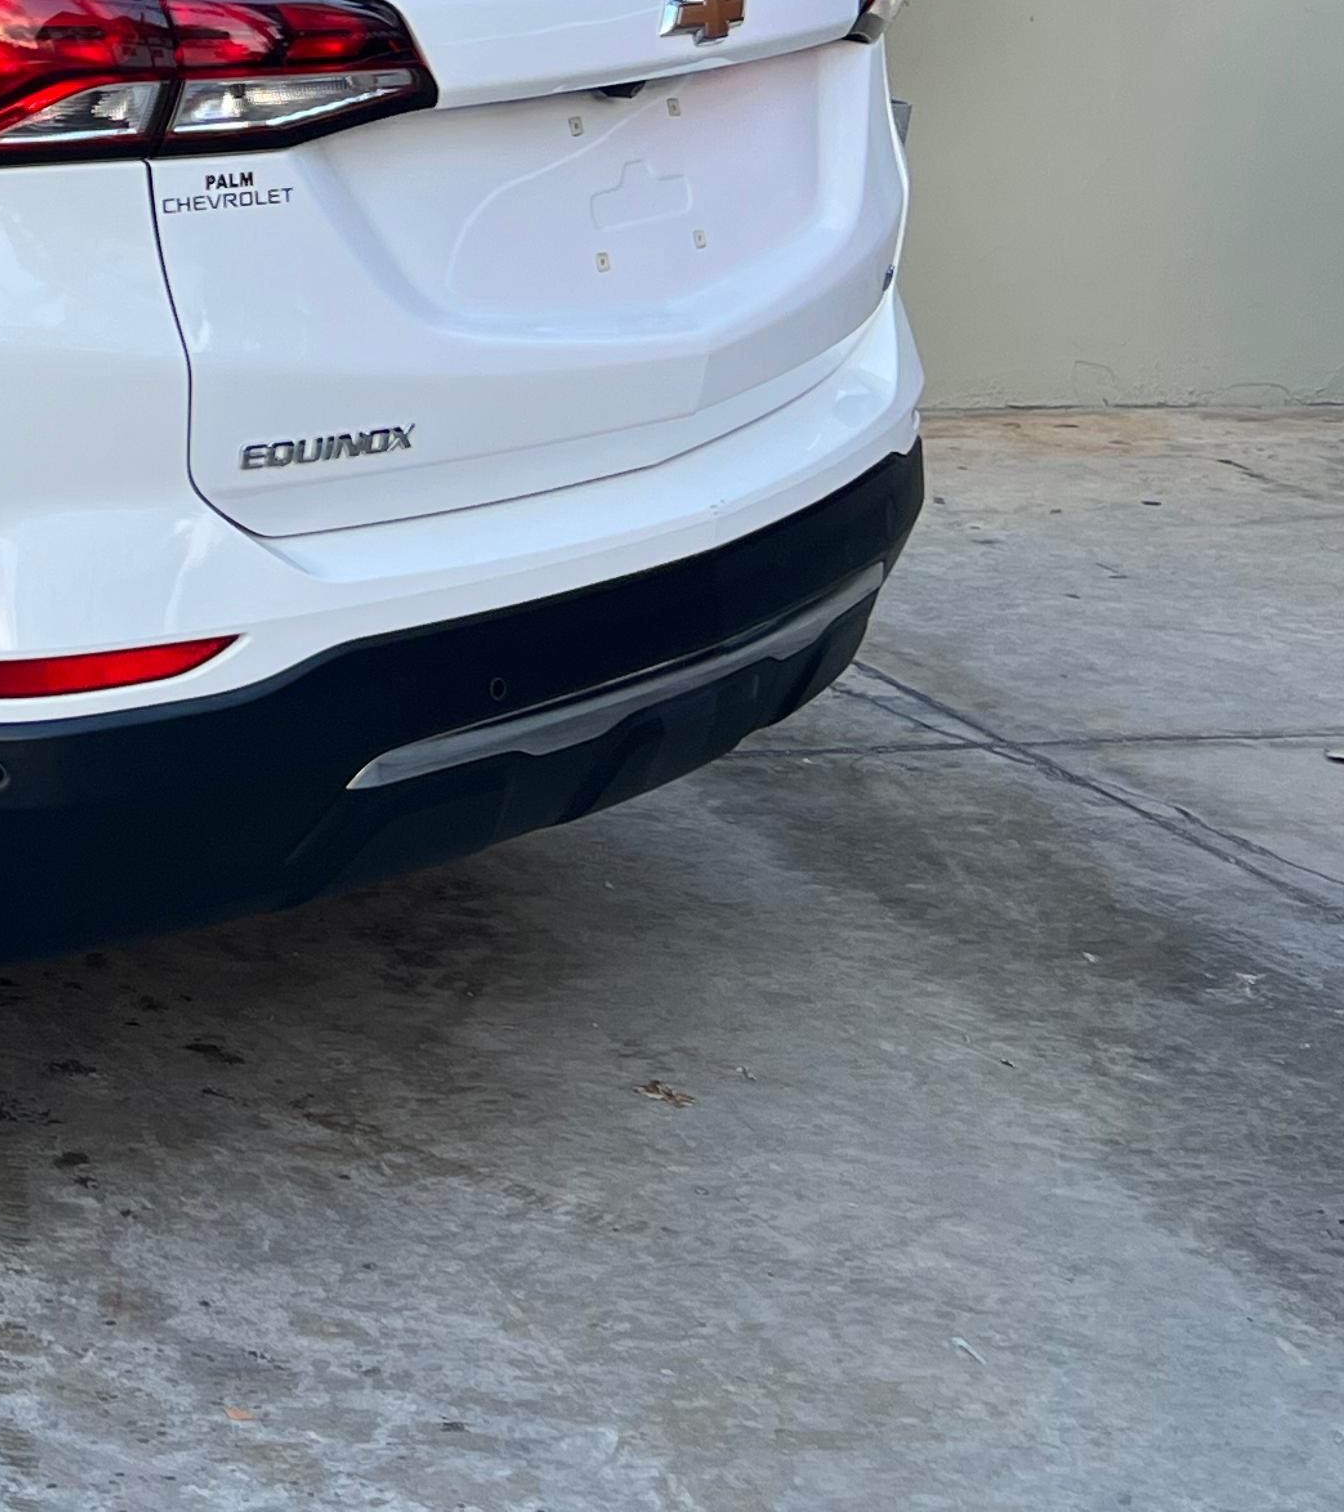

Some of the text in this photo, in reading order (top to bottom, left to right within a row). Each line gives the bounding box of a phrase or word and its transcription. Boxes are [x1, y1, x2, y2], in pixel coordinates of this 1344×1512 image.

[205, 172, 254, 190] PALM
[162, 187, 294, 214] CHEVROLET
[239, 423, 416, 470] EQUINOX
